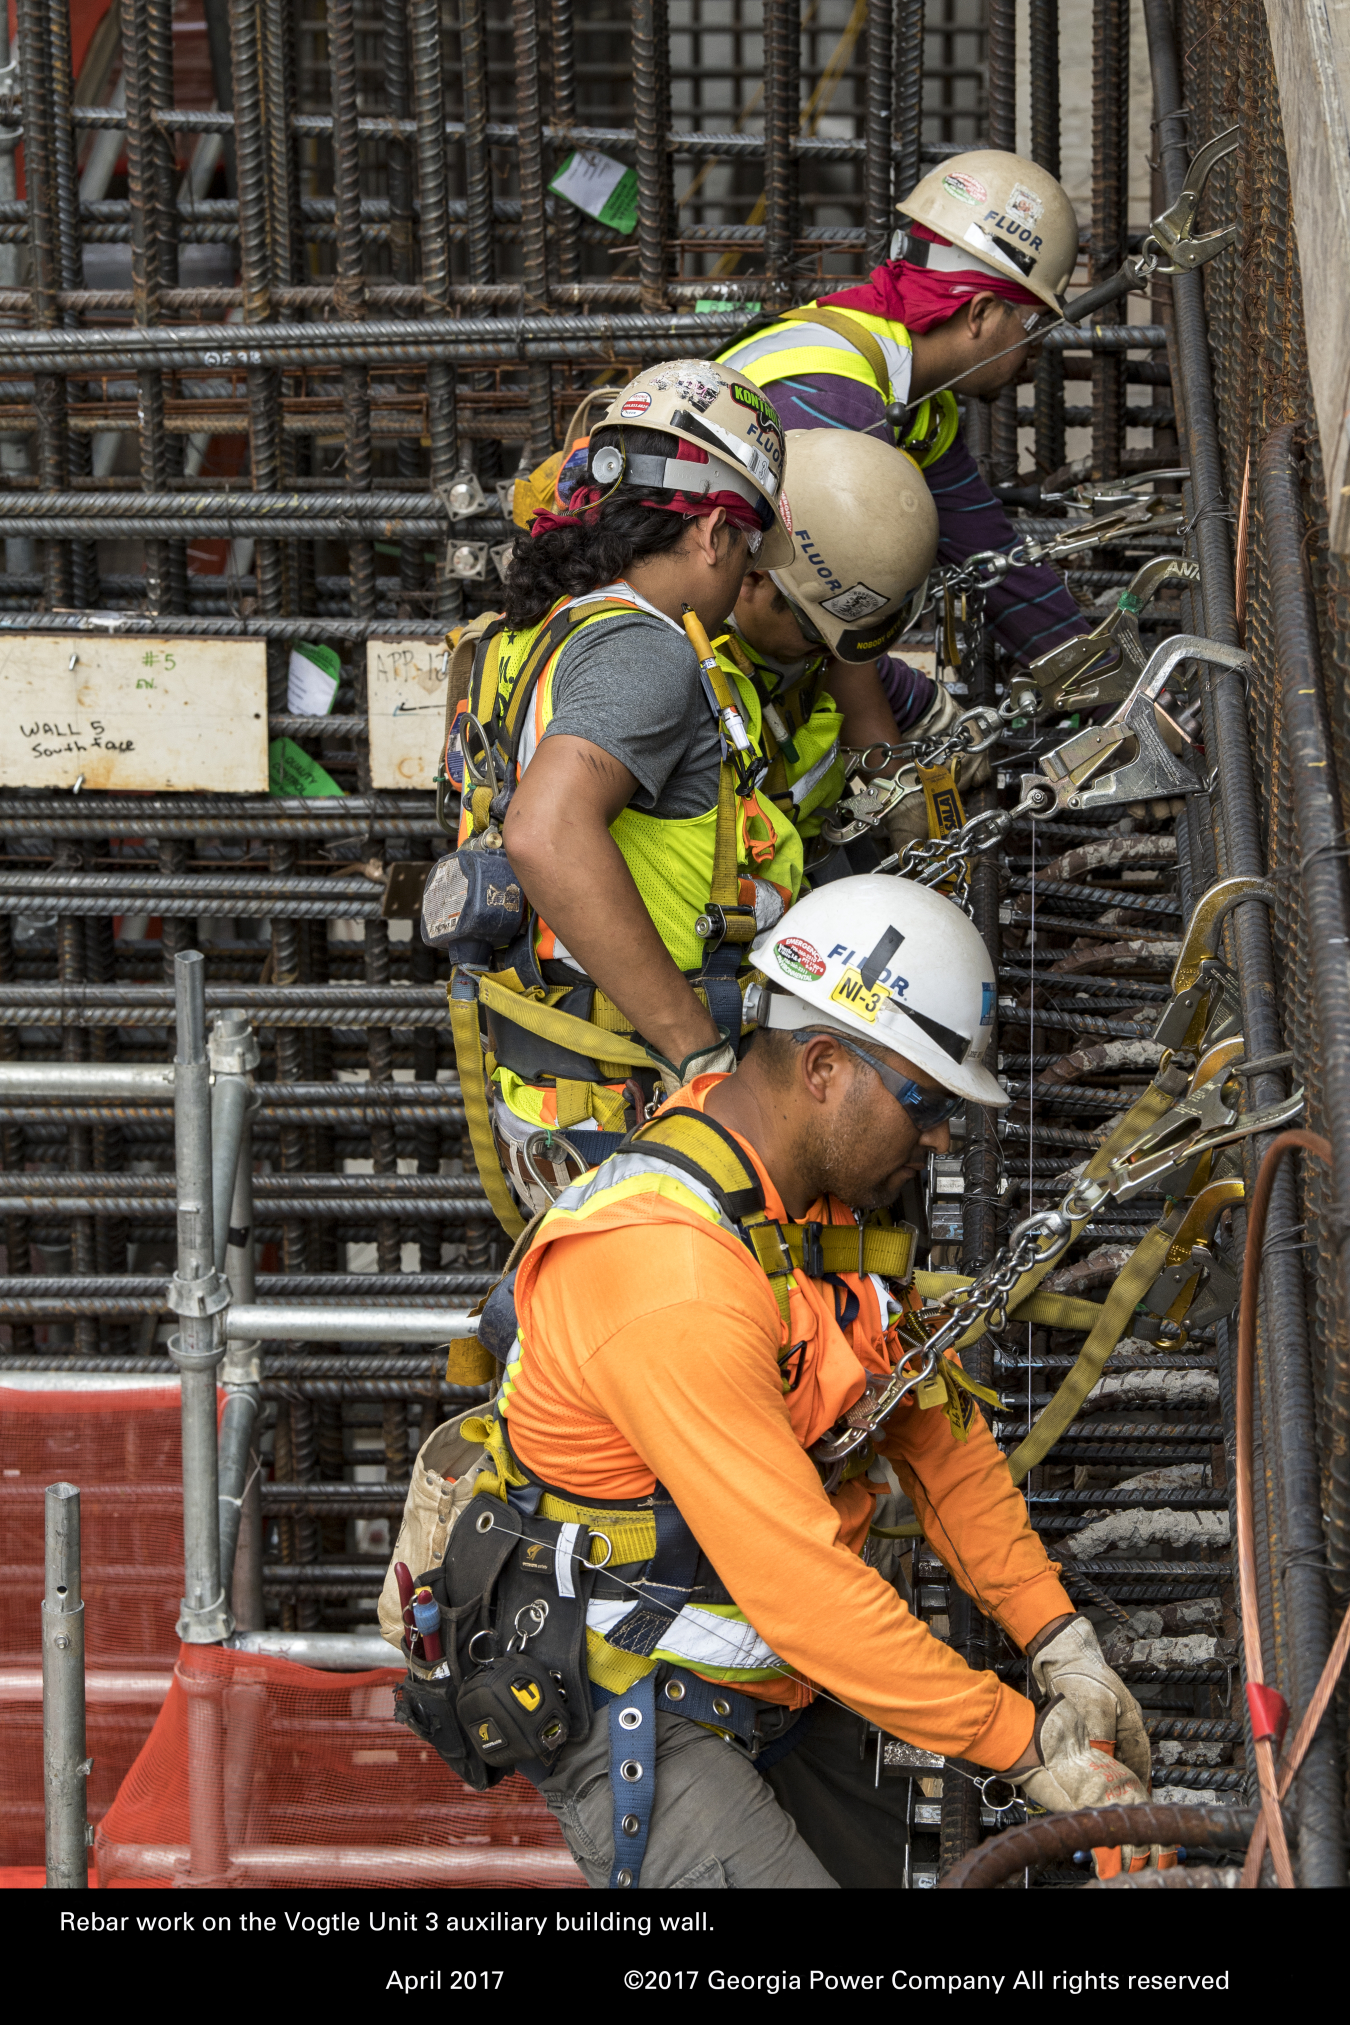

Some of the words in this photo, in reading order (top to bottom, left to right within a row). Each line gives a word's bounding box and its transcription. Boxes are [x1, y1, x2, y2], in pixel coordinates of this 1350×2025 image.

[983, 209, 1043, 252] FLUOR
[794, 529, 843, 592] FLUOR
[856, 635, 886, 650] NOBODY
[20, 721, 82, 738] WALL
[90, 720, 105, 736] 5
[32, 740, 87, 759] South
[940, 796, 958, 832] SALA
[785, 938, 823, 963] EMERGENCY
[776, 954, 813, 981] ENVIRONMENTAL
[838, 976, 882, 1013] NI-3
